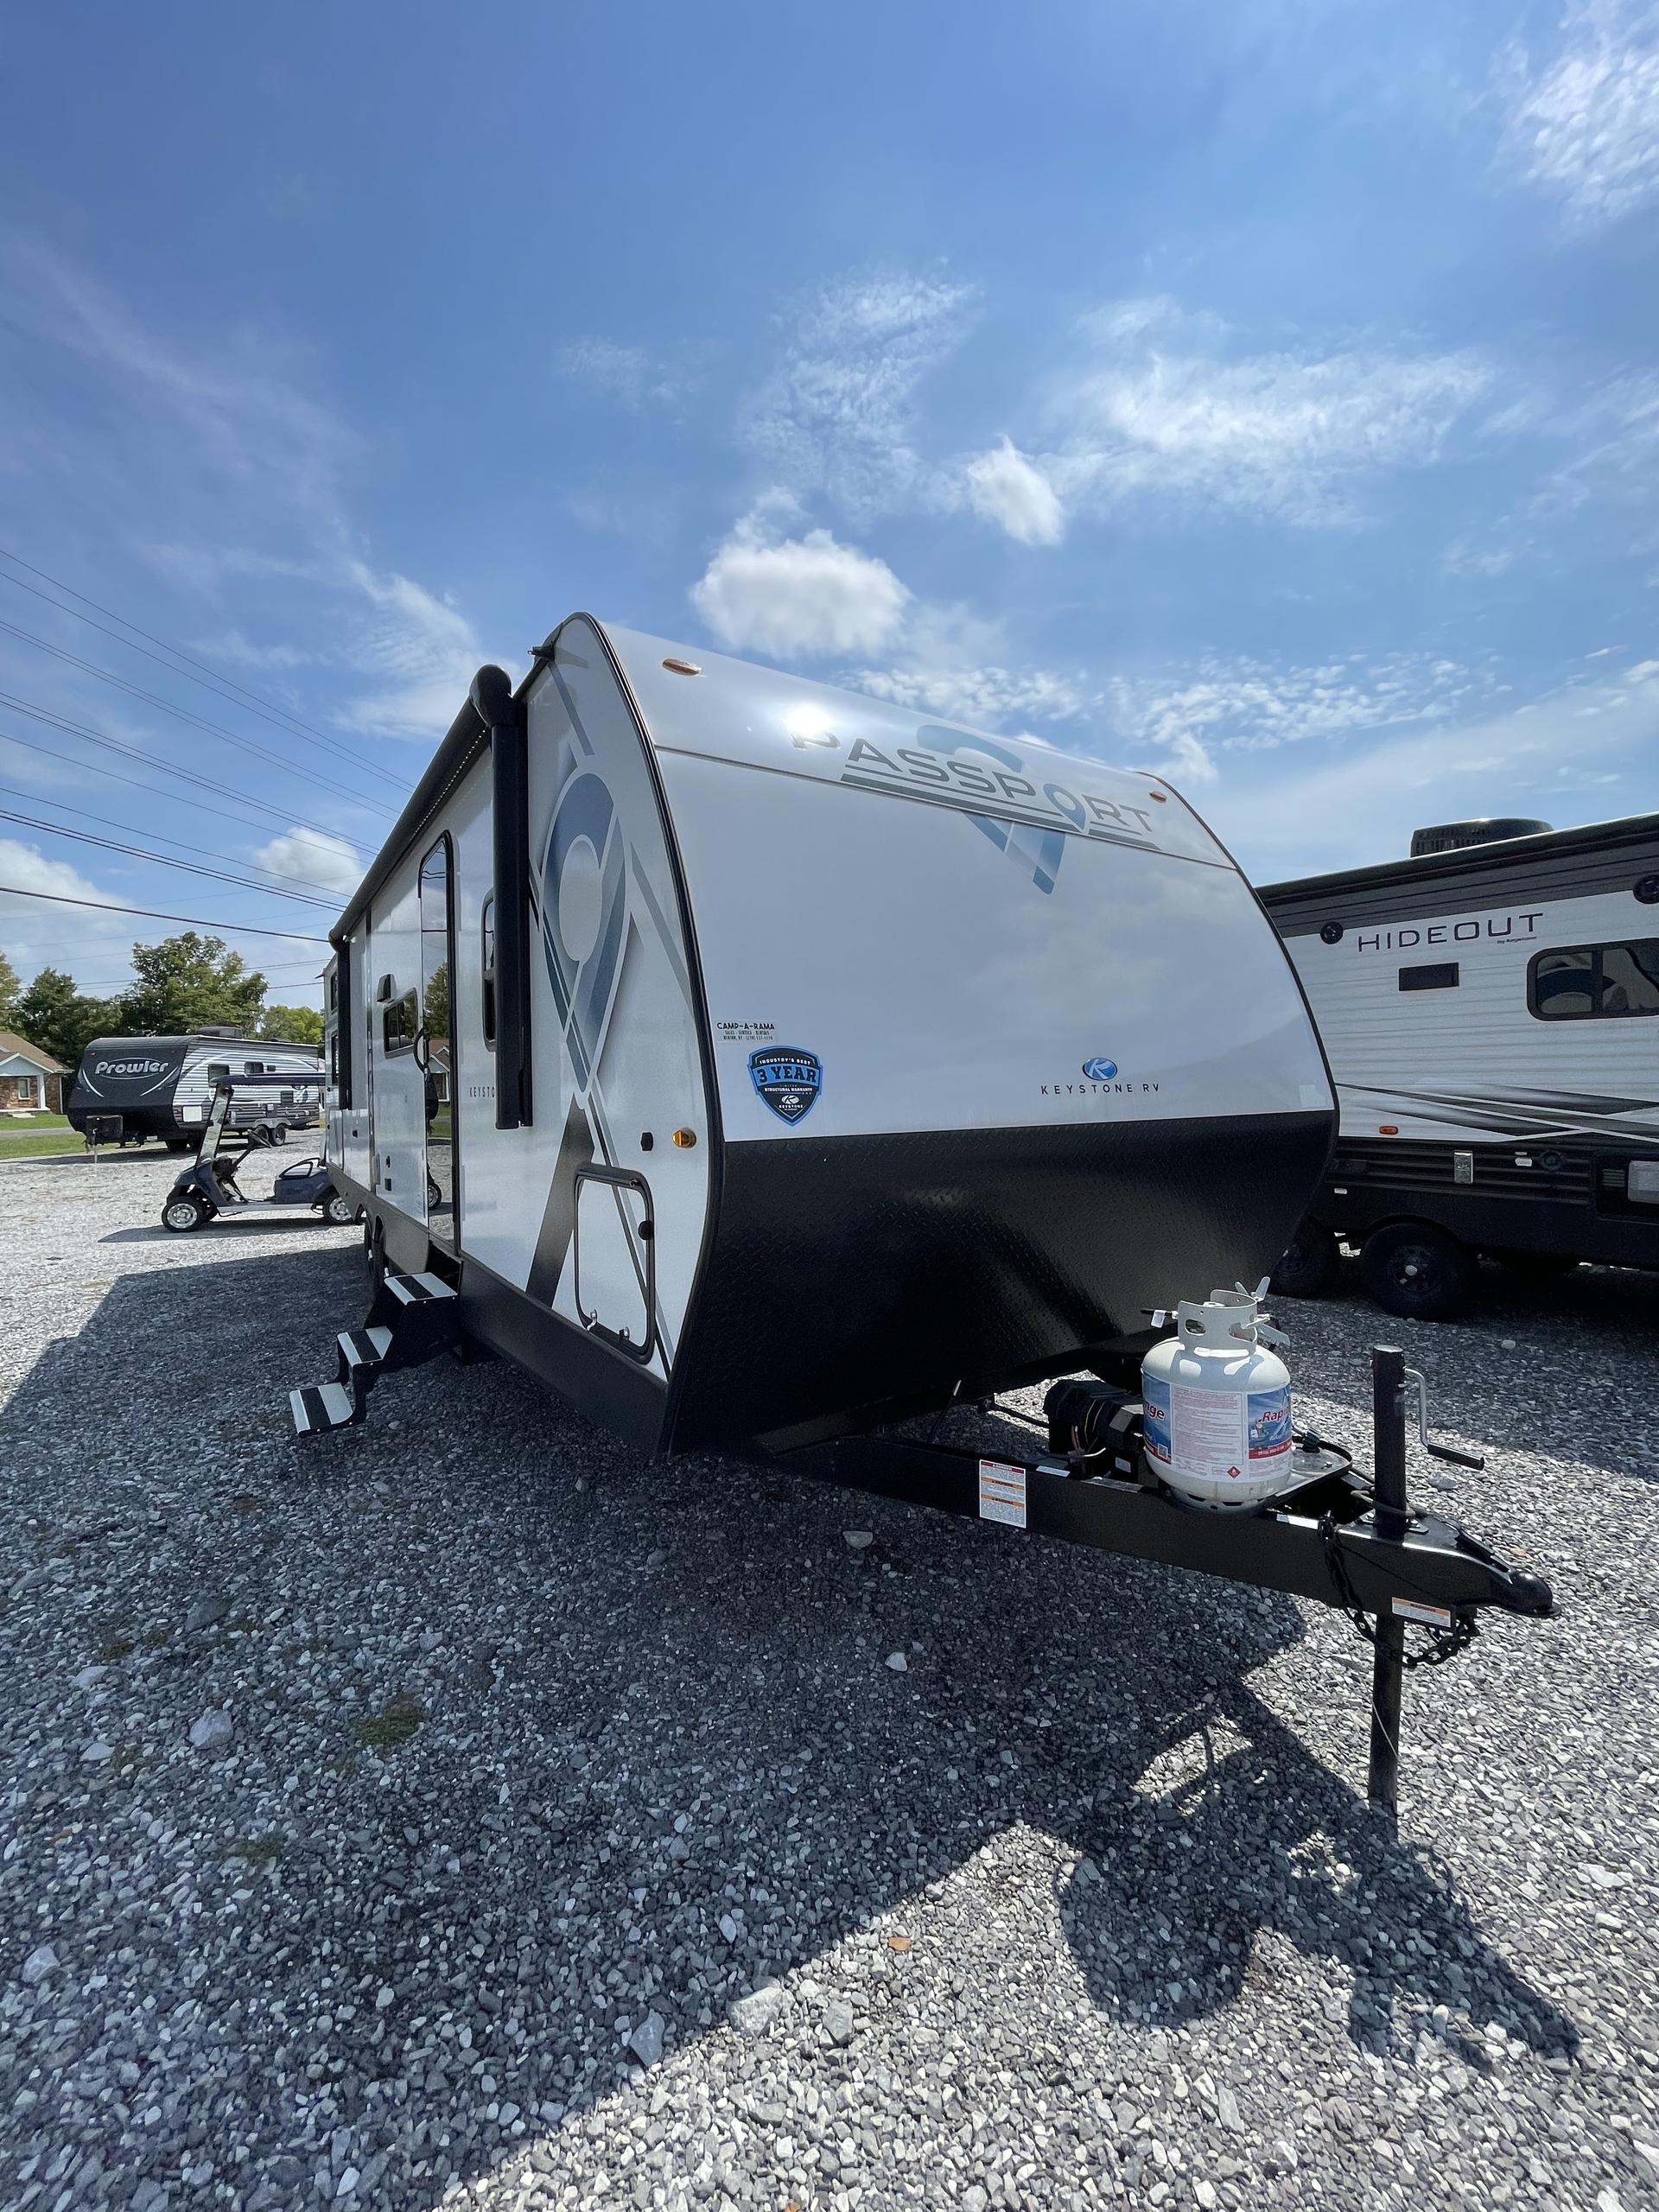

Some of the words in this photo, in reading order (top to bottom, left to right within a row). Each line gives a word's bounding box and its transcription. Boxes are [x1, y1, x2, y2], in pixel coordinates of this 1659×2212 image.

[1358, 912, 1544, 952] HIDEOUT
[94, 1060, 169, 1074] Prowler
[756, 1068, 768, 1083] 3
[771, 1065, 817, 1083] YEAR
[1040, 1084, 1133, 1095] KEYSTONE
[1143, 1084, 1160, 1092] RV
